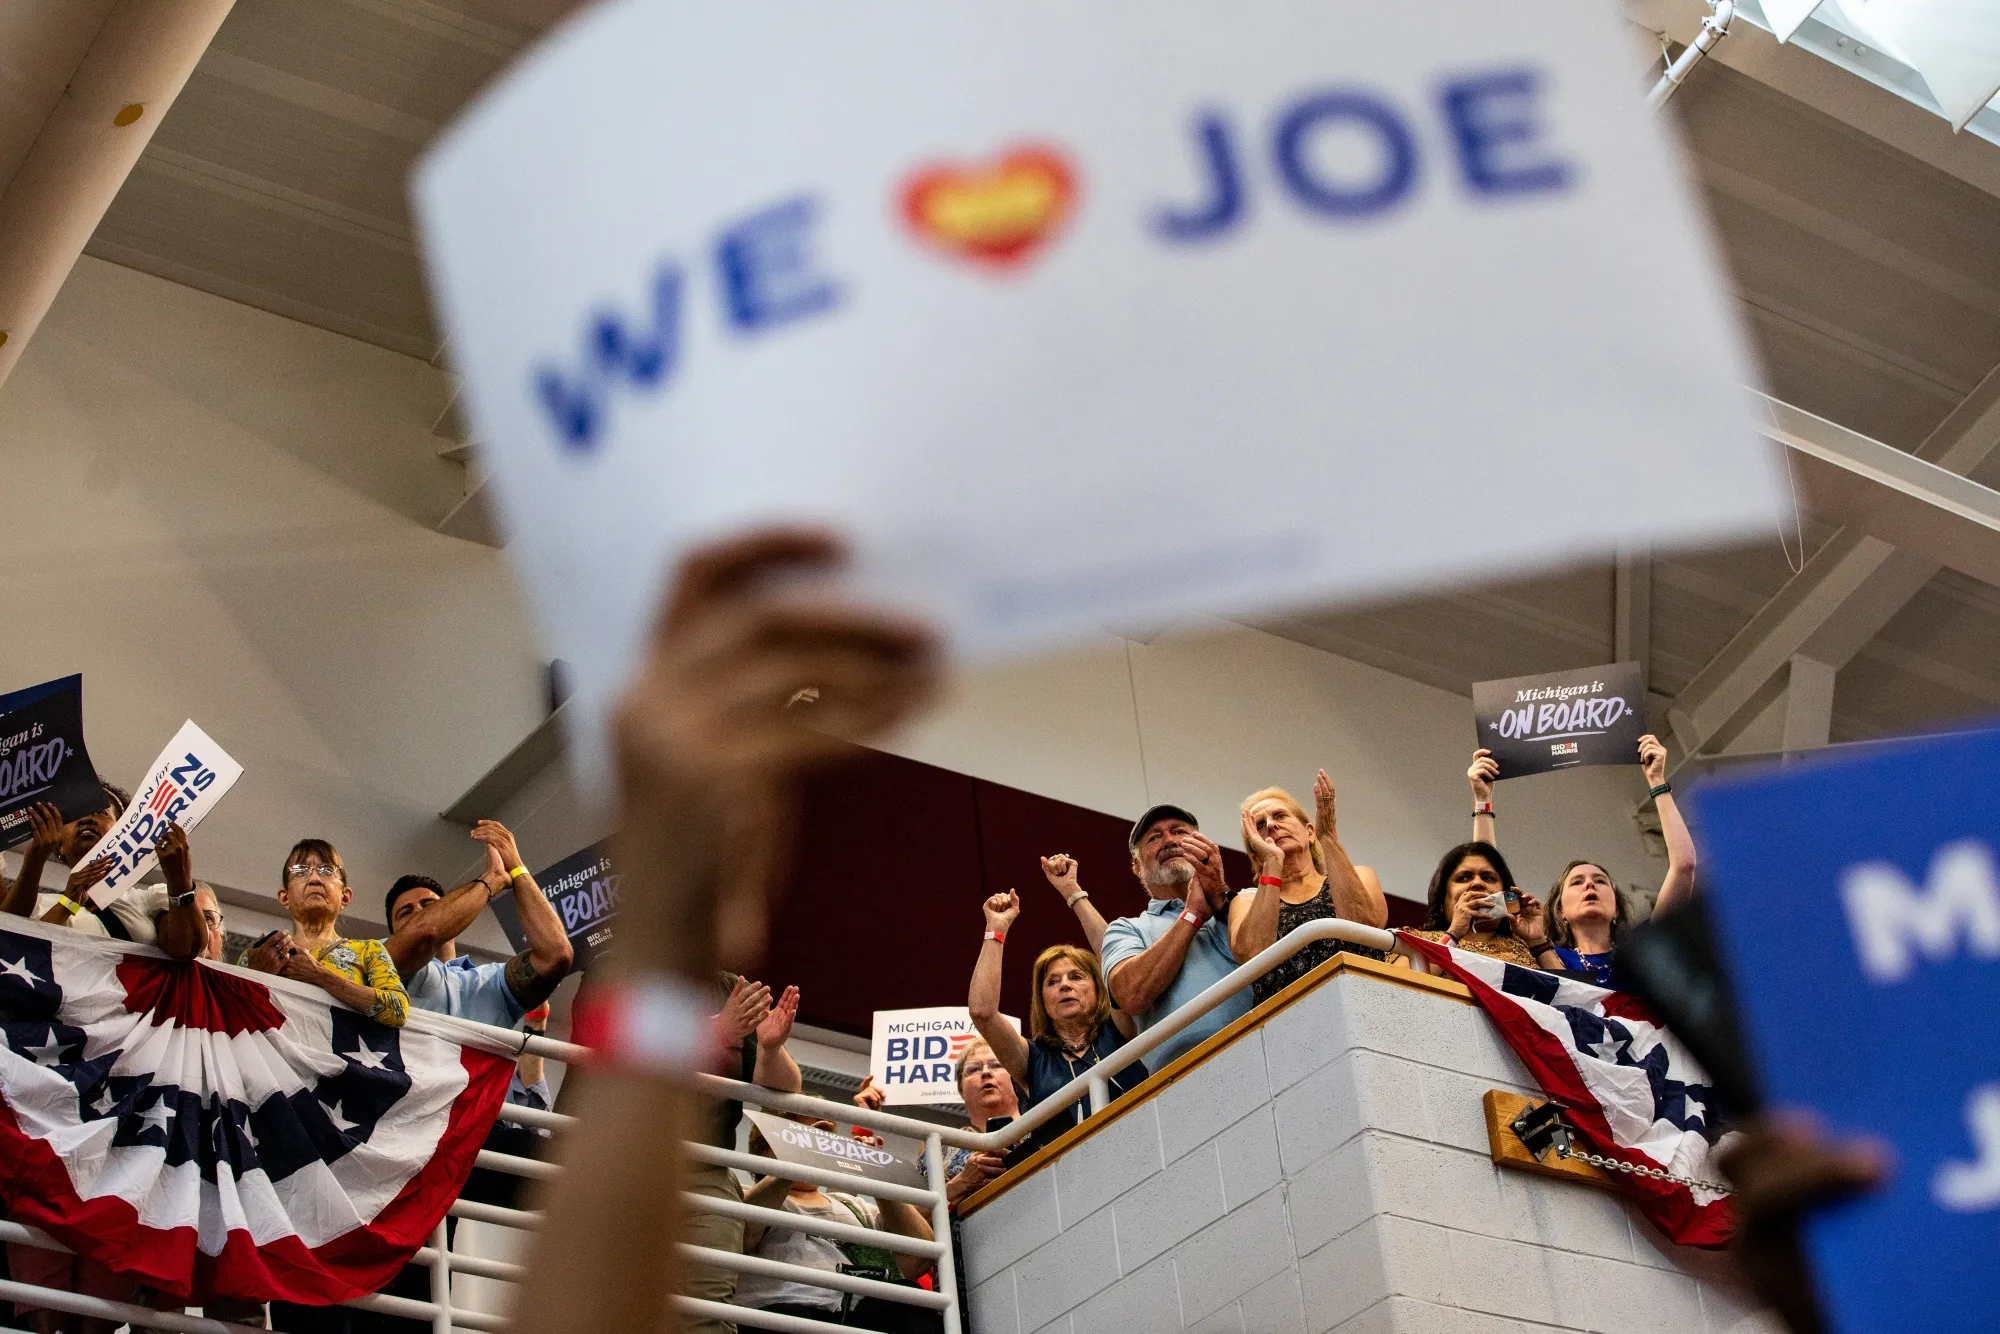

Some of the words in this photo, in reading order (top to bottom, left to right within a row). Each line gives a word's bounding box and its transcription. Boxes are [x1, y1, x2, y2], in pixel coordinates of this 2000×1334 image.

[529, 195, 844, 456] WE
[1148, 66, 1581, 245] JOE
[1515, 685, 1588, 702] Michigan
[1591, 681, 1604, 693] is
[1499, 704, 1534, 739] ON
[1537, 697, 1625, 735] BOARD
[32, 722, 44, 738] is
[155, 762, 170, 789] for
[600, 858, 612, 871] is
[888, 1020, 965, 1034] MICHIGAN
[886, 1034, 977, 1062] BIDE
[885, 1063, 959, 1084] HAR
[920, 1089, 961, 1097] JoeBiden.co
[781, 1129, 813, 1149] ON
[815, 1136, 894, 1166] BOARD
